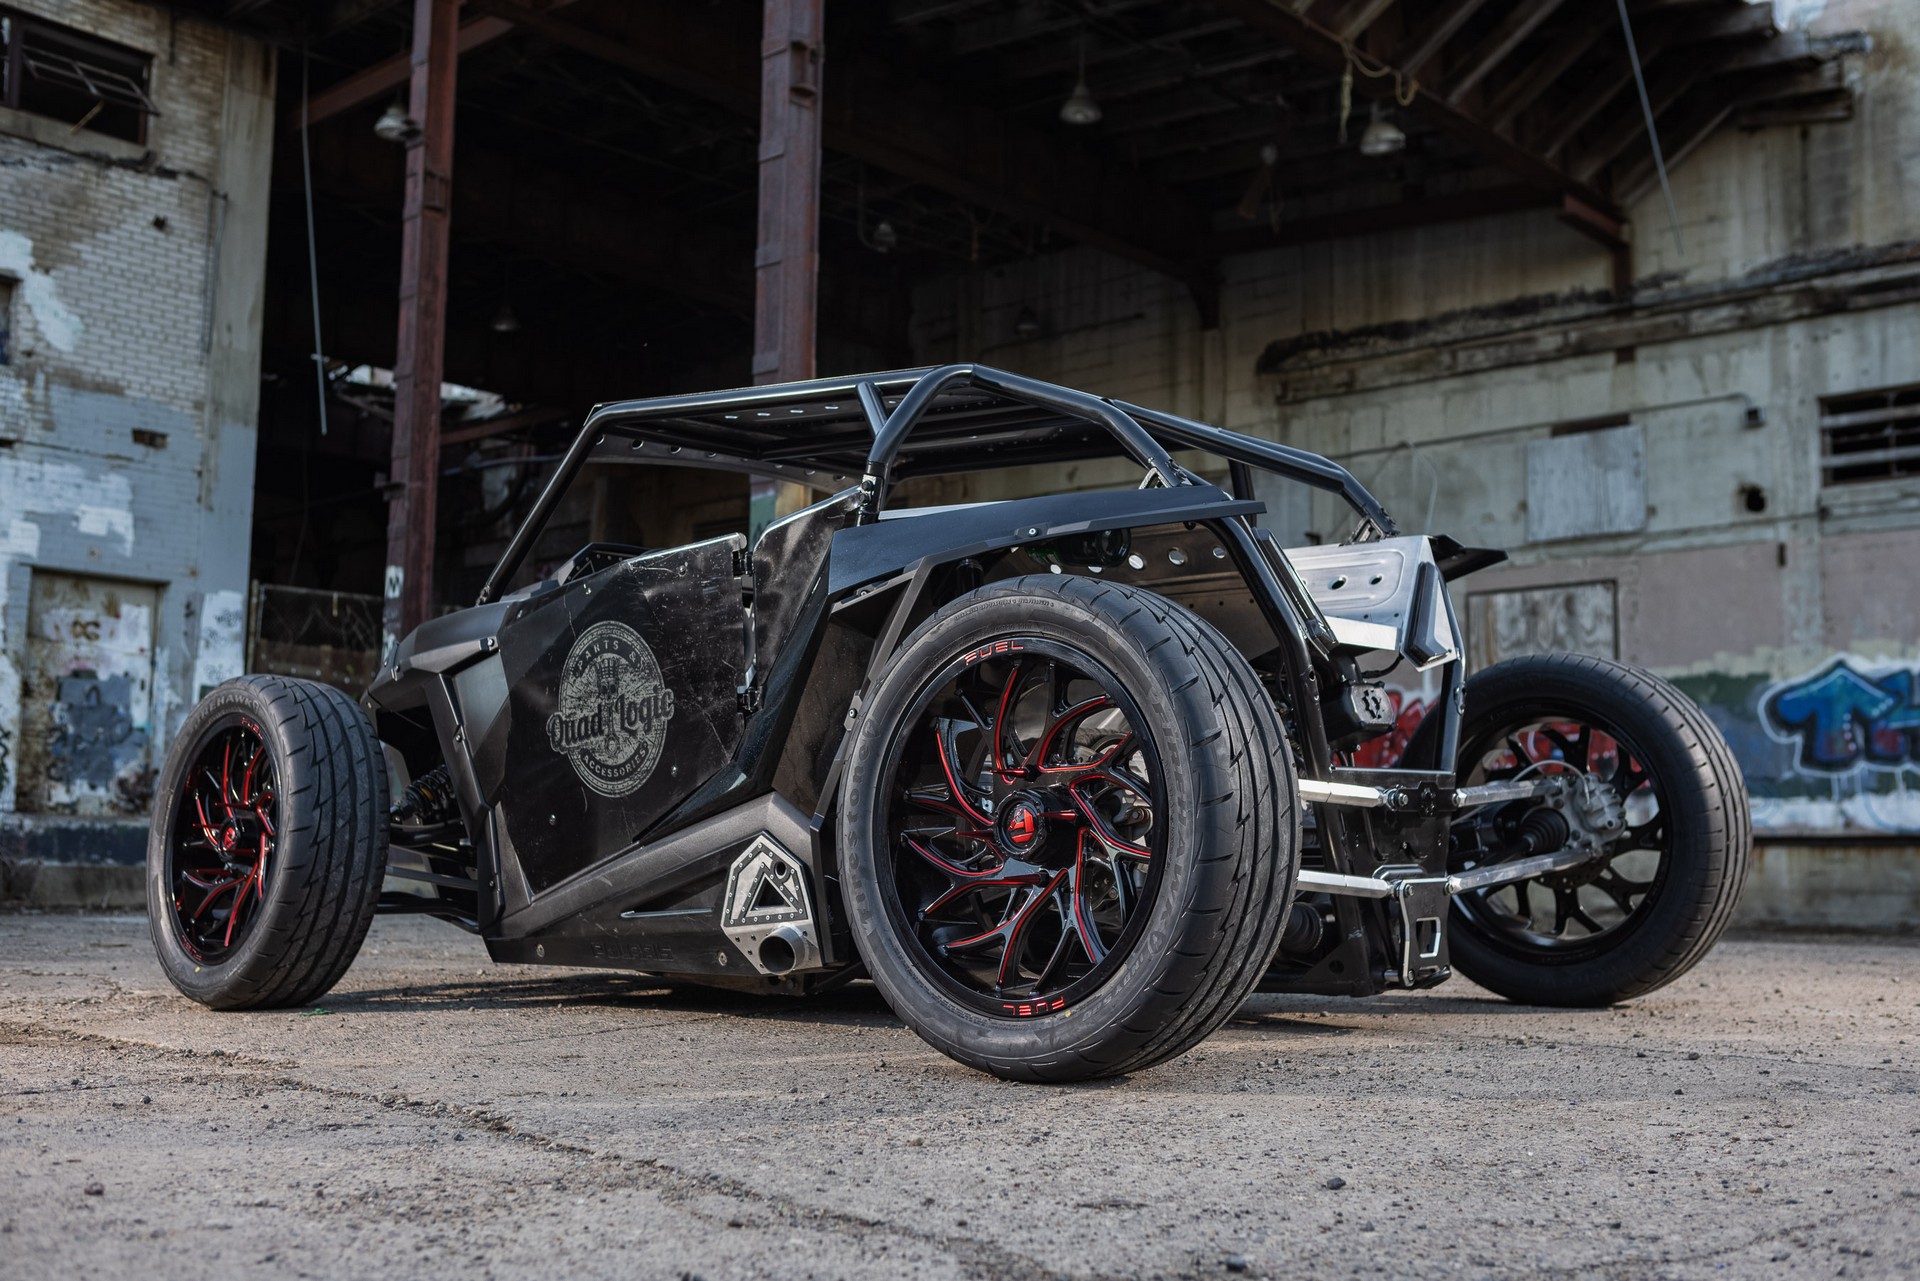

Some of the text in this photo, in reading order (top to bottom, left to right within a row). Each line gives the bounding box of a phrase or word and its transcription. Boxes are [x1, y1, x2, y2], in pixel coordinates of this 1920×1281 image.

[576, 639, 619, 672] PARTS
[964, 640, 1024, 666] FUEL
[549, 682, 674, 749] Quad Logic
[583, 750, 647, 778] ACCESSORIES
[1152, 702, 1187, 925] FIREHAWK
[847, 744, 873, 924] Firestone
[1003, 996, 1065, 1016] FUEL
